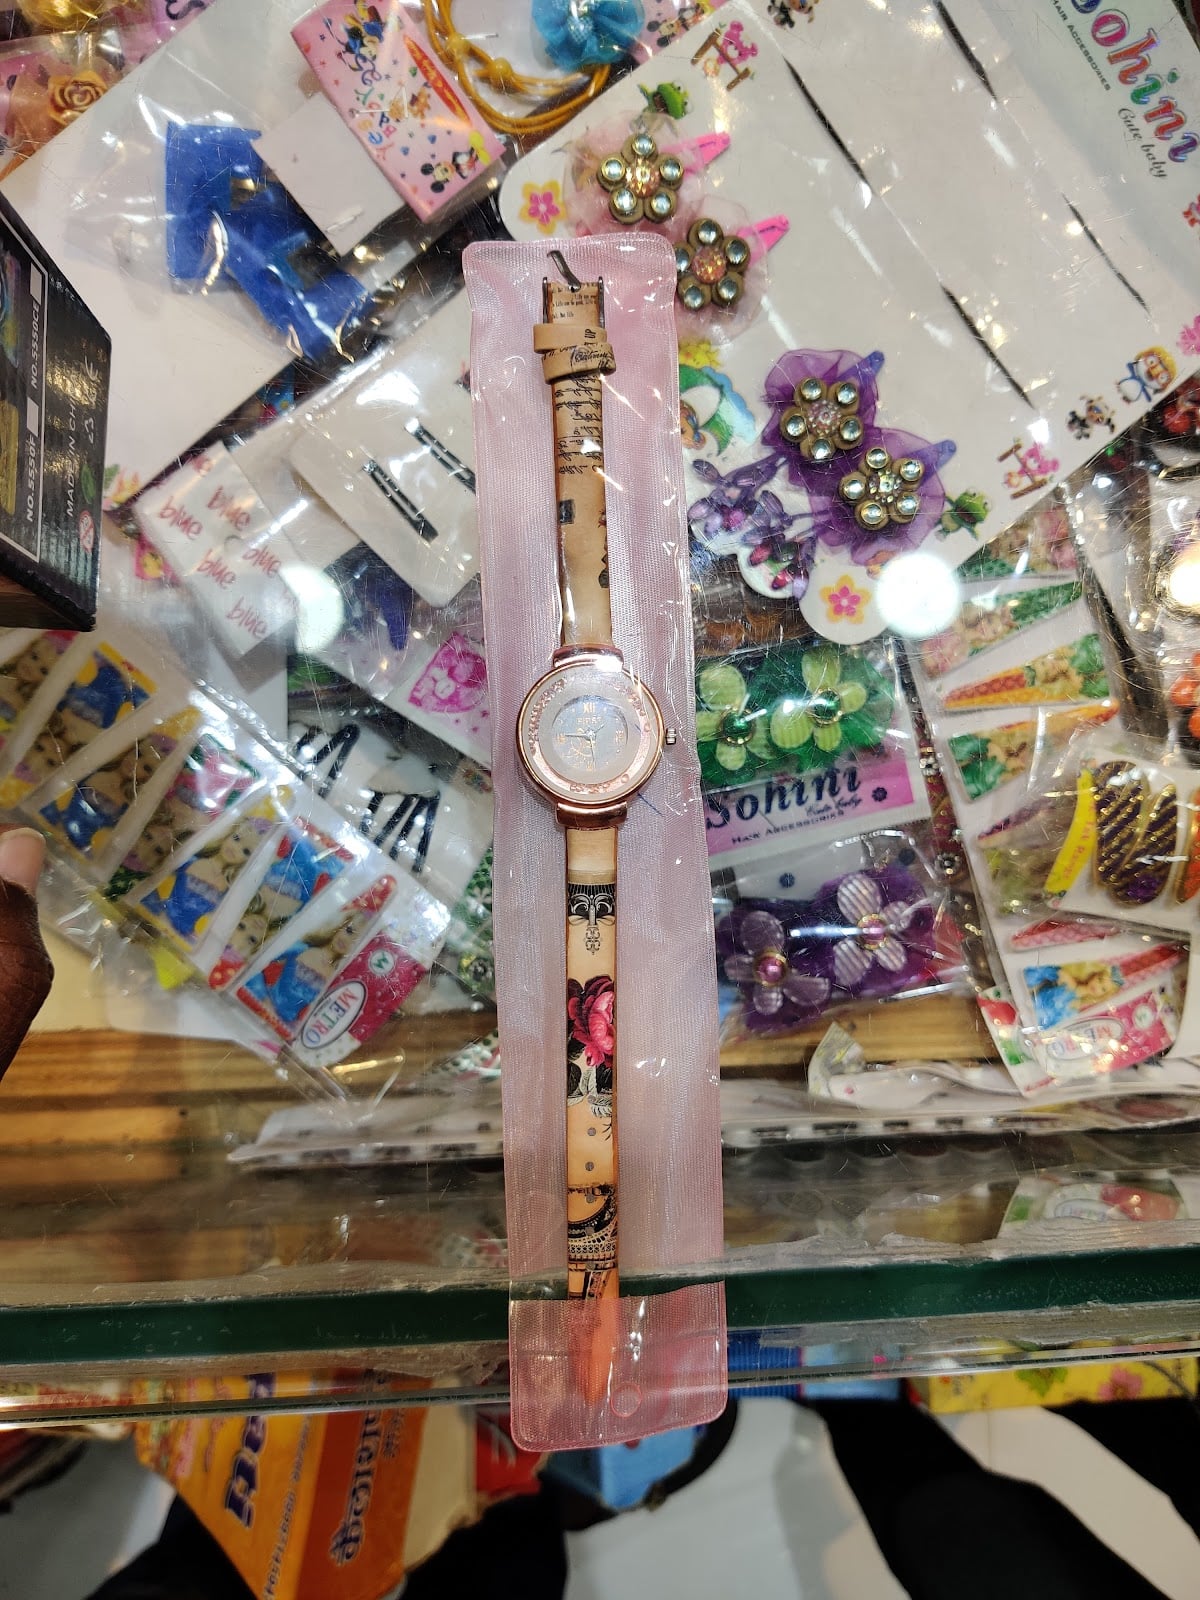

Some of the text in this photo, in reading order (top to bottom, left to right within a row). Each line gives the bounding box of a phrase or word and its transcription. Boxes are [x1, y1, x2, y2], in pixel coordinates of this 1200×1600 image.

[159, 496, 203, 540] blue
[208, 486, 250, 531] blue
[197, 549, 236, 589] blue
[226, 597, 268, 639] blue
[305, 987, 359, 1044] METRO
